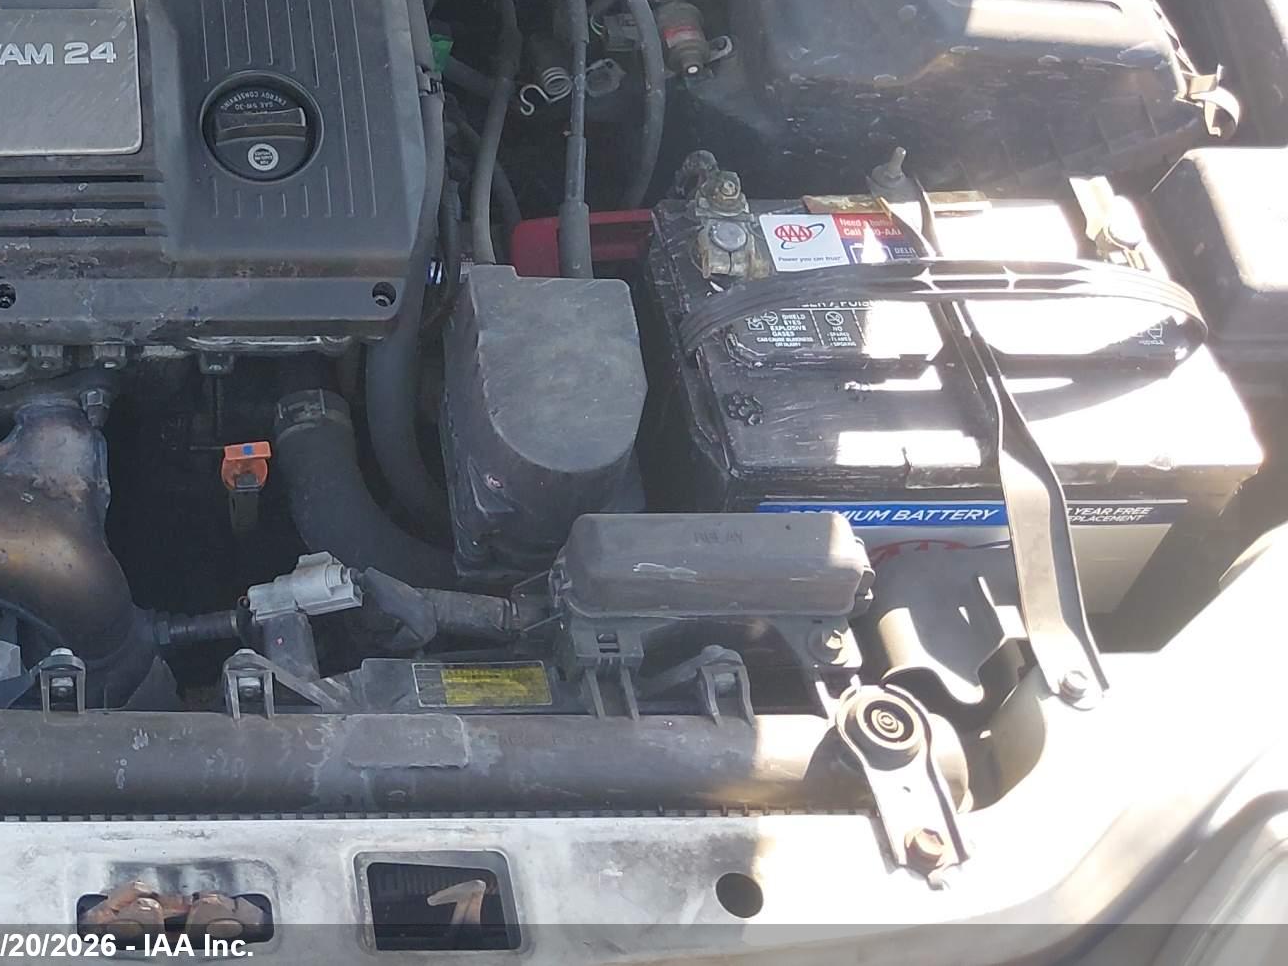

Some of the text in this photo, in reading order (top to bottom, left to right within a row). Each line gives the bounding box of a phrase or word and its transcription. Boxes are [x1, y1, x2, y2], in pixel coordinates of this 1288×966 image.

[64, 41, 117, 65] 24
[775, 224, 813, 242] AAA
[891, 509, 999, 521] BATTERY
[1074, 507, 1112, 515] YEAR
[1113, 507, 1153, 515] FREE
